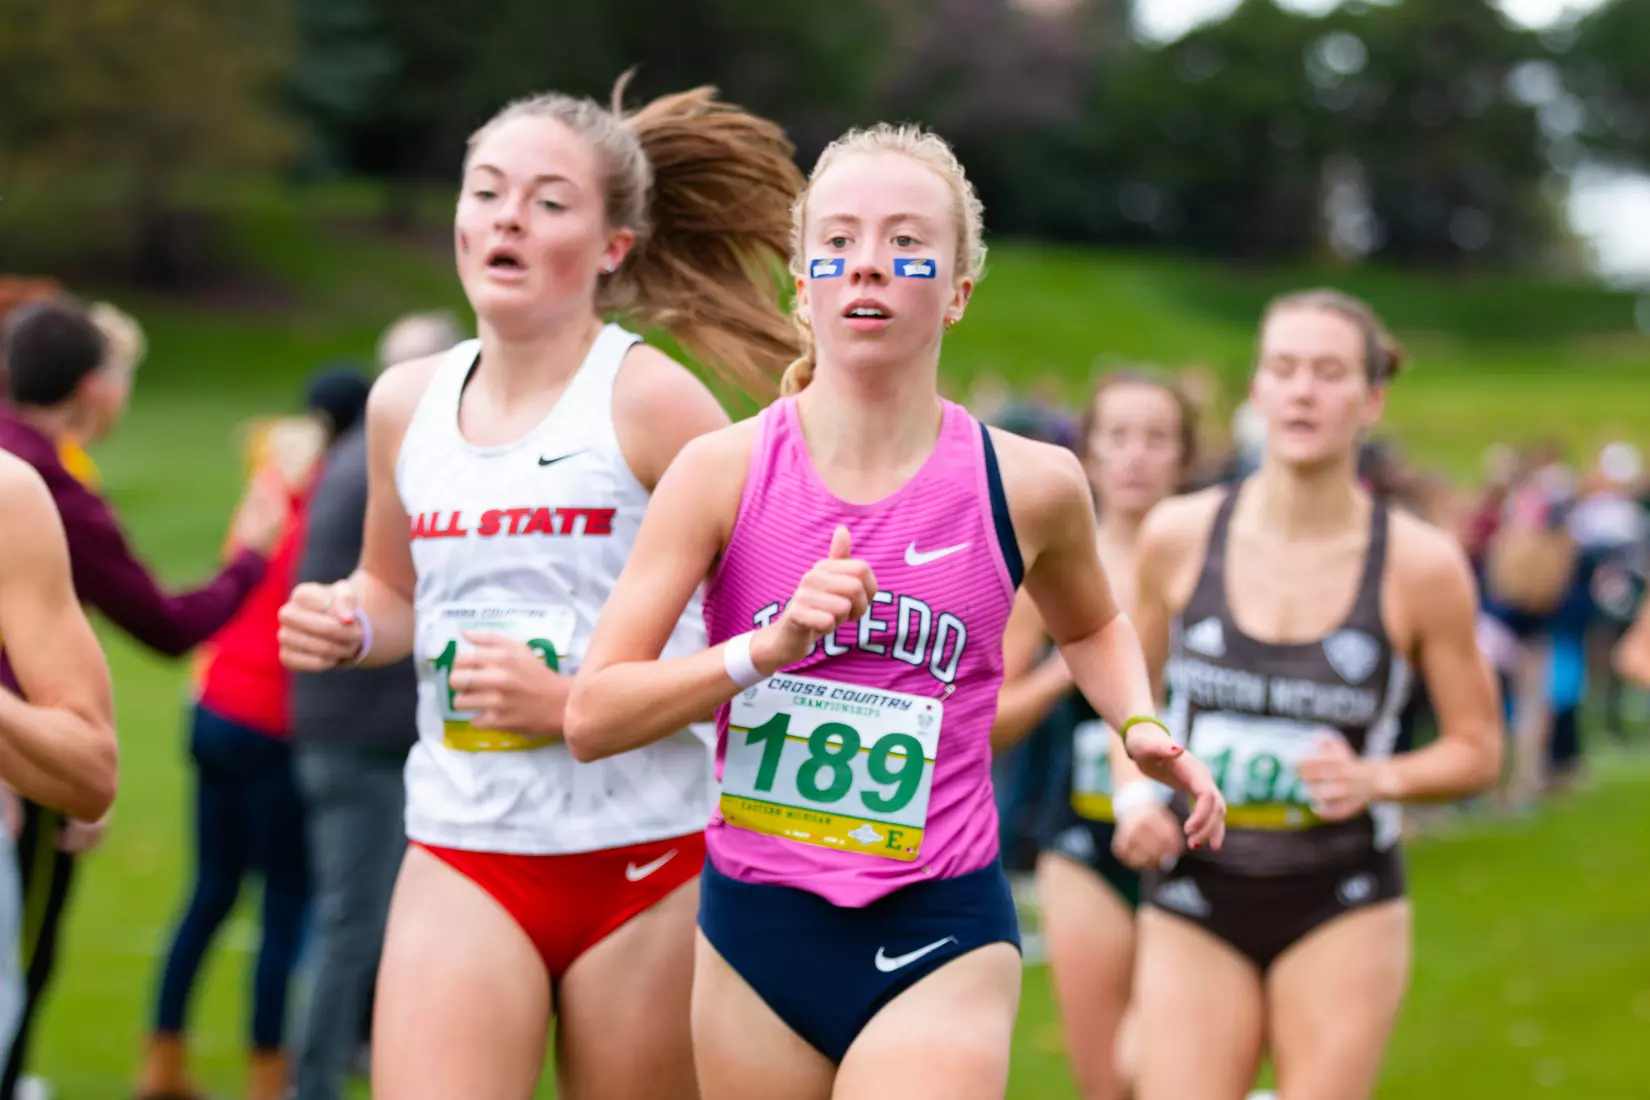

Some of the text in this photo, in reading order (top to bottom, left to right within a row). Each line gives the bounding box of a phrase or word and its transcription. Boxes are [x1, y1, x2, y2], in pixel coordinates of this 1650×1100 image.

[408, 507, 616, 539] ALL STATE
[753, 590, 967, 684] TLEDO
[767, 678, 912, 710] CROSS COUNTRY
[793, 696, 881, 717] CHAMPIONSHIPS
[745, 712, 924, 813] 189
[885, 829, 904, 850] E
